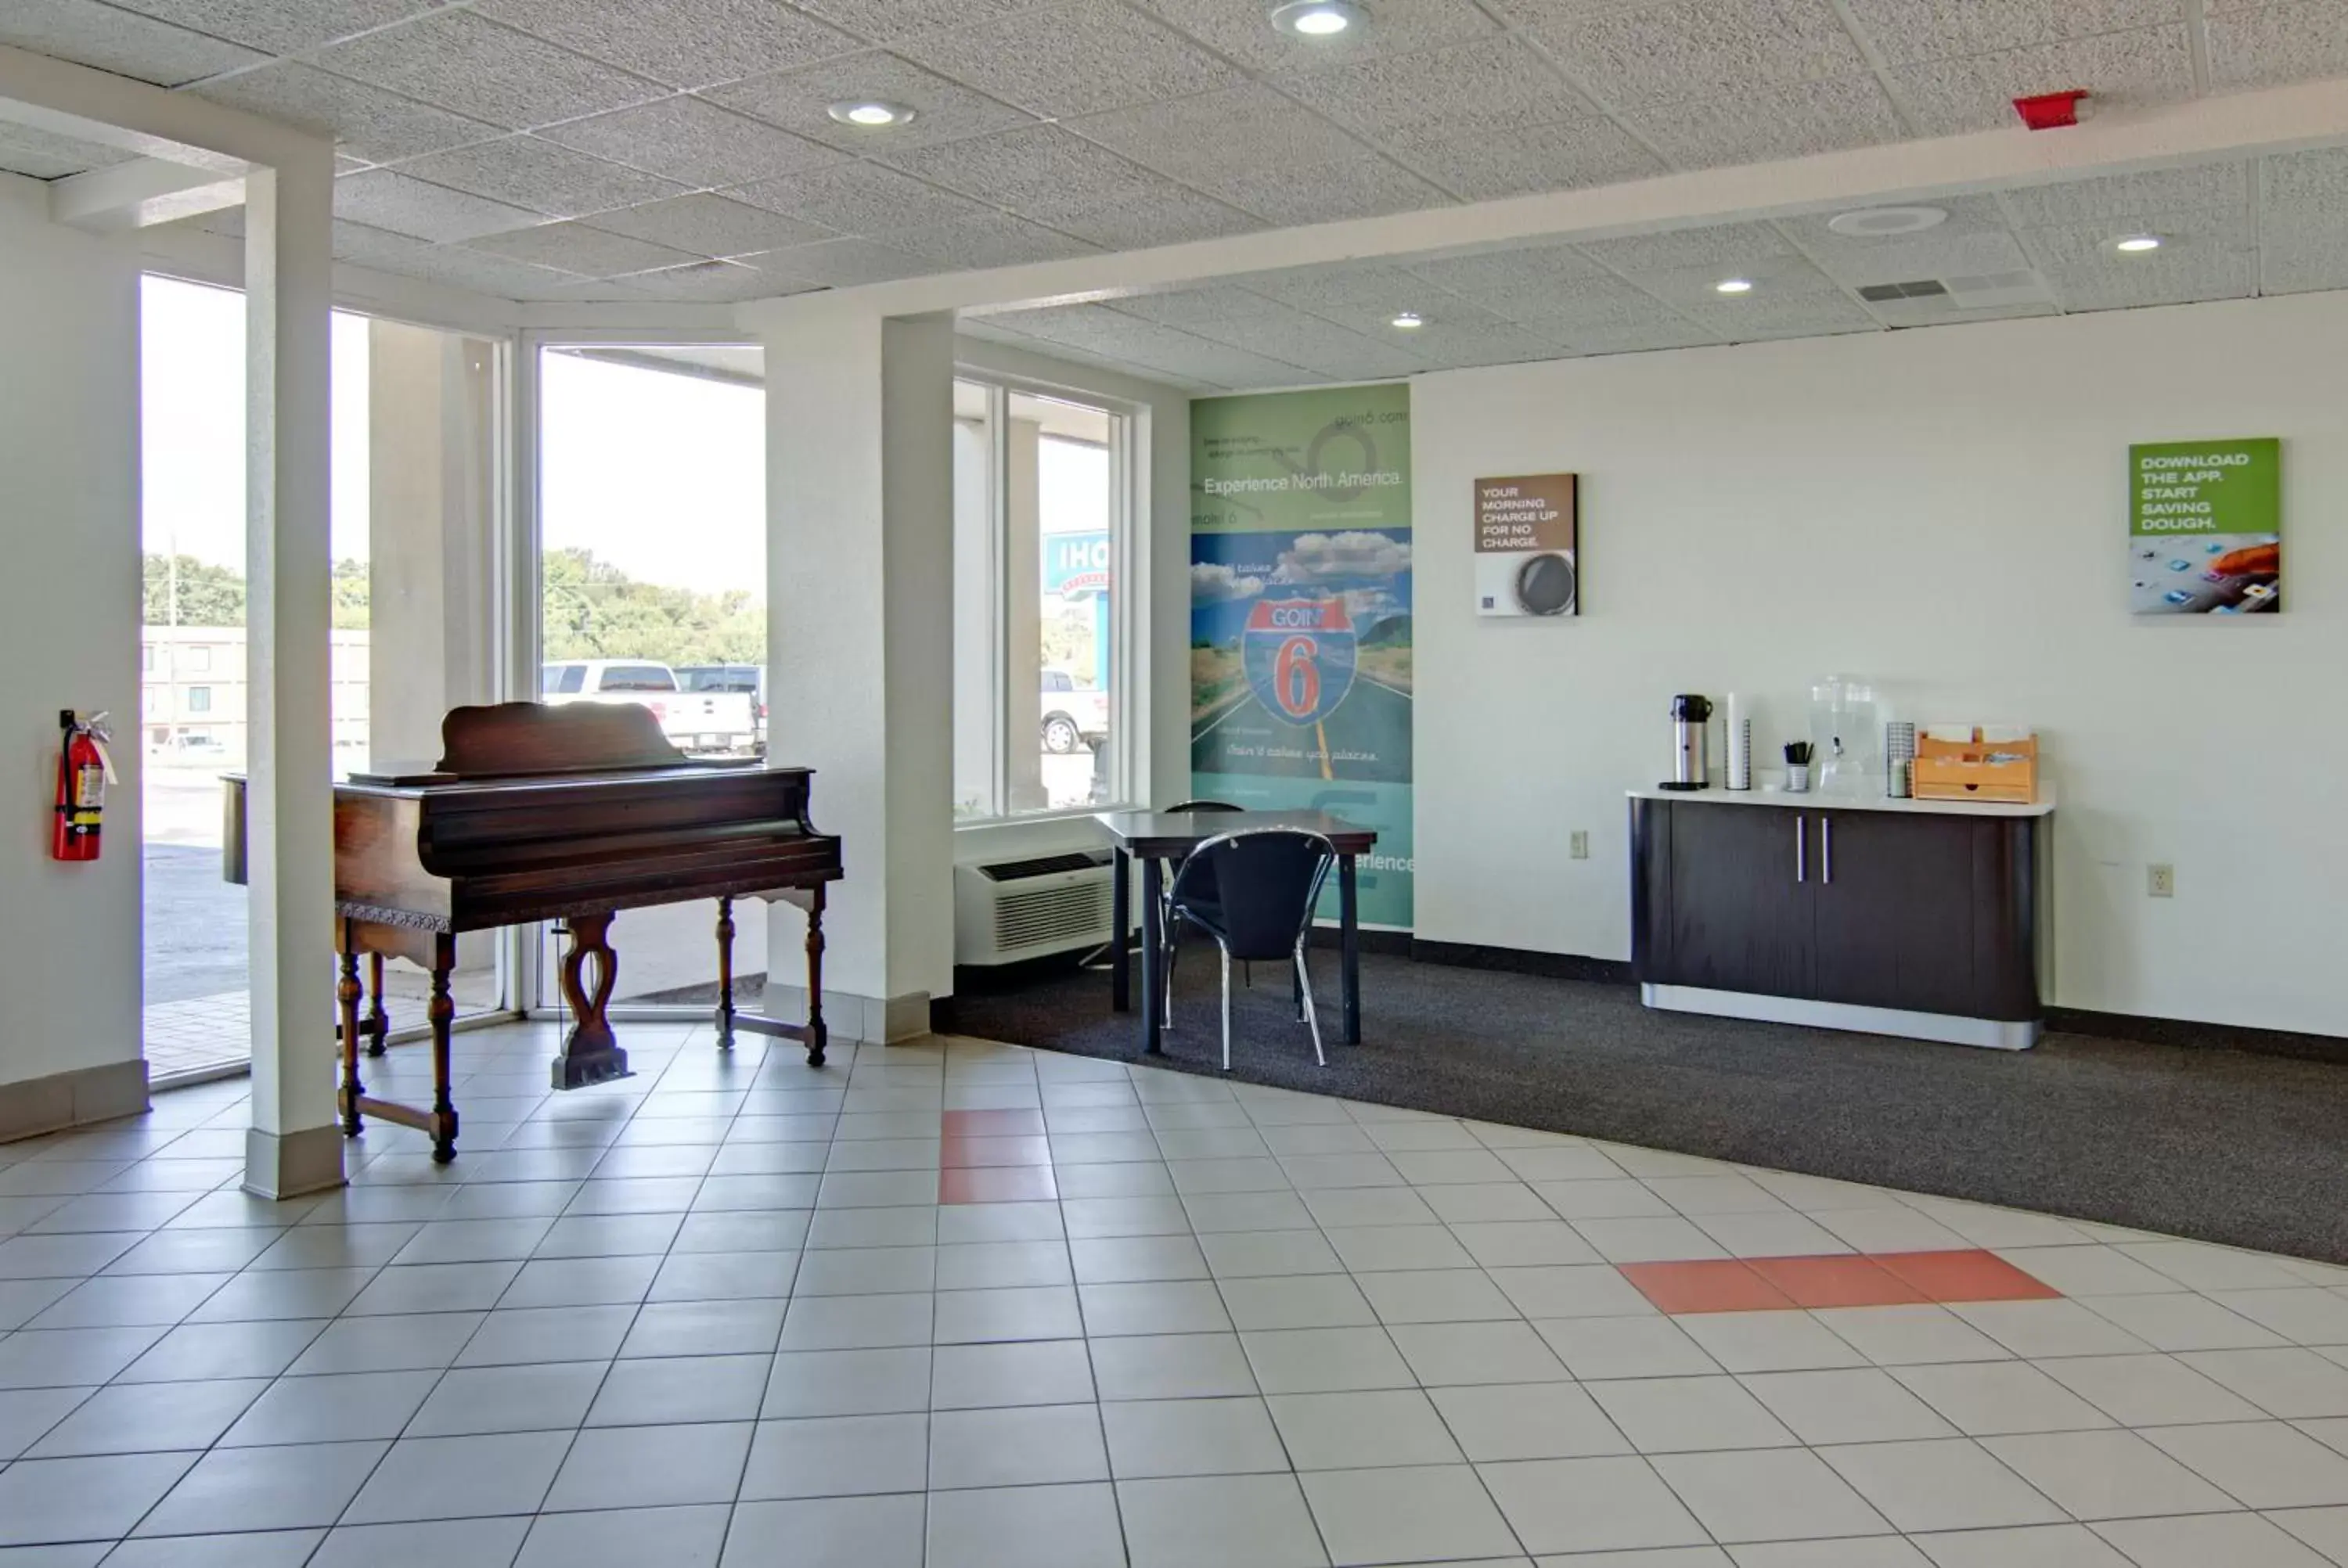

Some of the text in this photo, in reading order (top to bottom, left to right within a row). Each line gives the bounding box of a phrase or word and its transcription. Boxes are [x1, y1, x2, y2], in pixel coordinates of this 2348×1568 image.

[2141, 453, 2249, 469] DOWNLOAD
[1205, 476, 1288, 496] Experience
[1291, 472, 1331, 490] North
[2141, 471, 2224, 484] THE APP.
[1482, 487, 1518, 498] YOUR
[2141, 487, 2198, 500] START
[1482, 498, 1546, 511] MORNING
[2141, 502, 2211, 515] SAVING
[1482, 511, 1558, 523] CHARGE UP
[2141, 517, 2216, 530] DOUGH.
[1483, 524, 1531, 535] FOR NO
[1482, 537, 1539, 548] CHARGE.
[1274, 635, 1320, 719] 6
